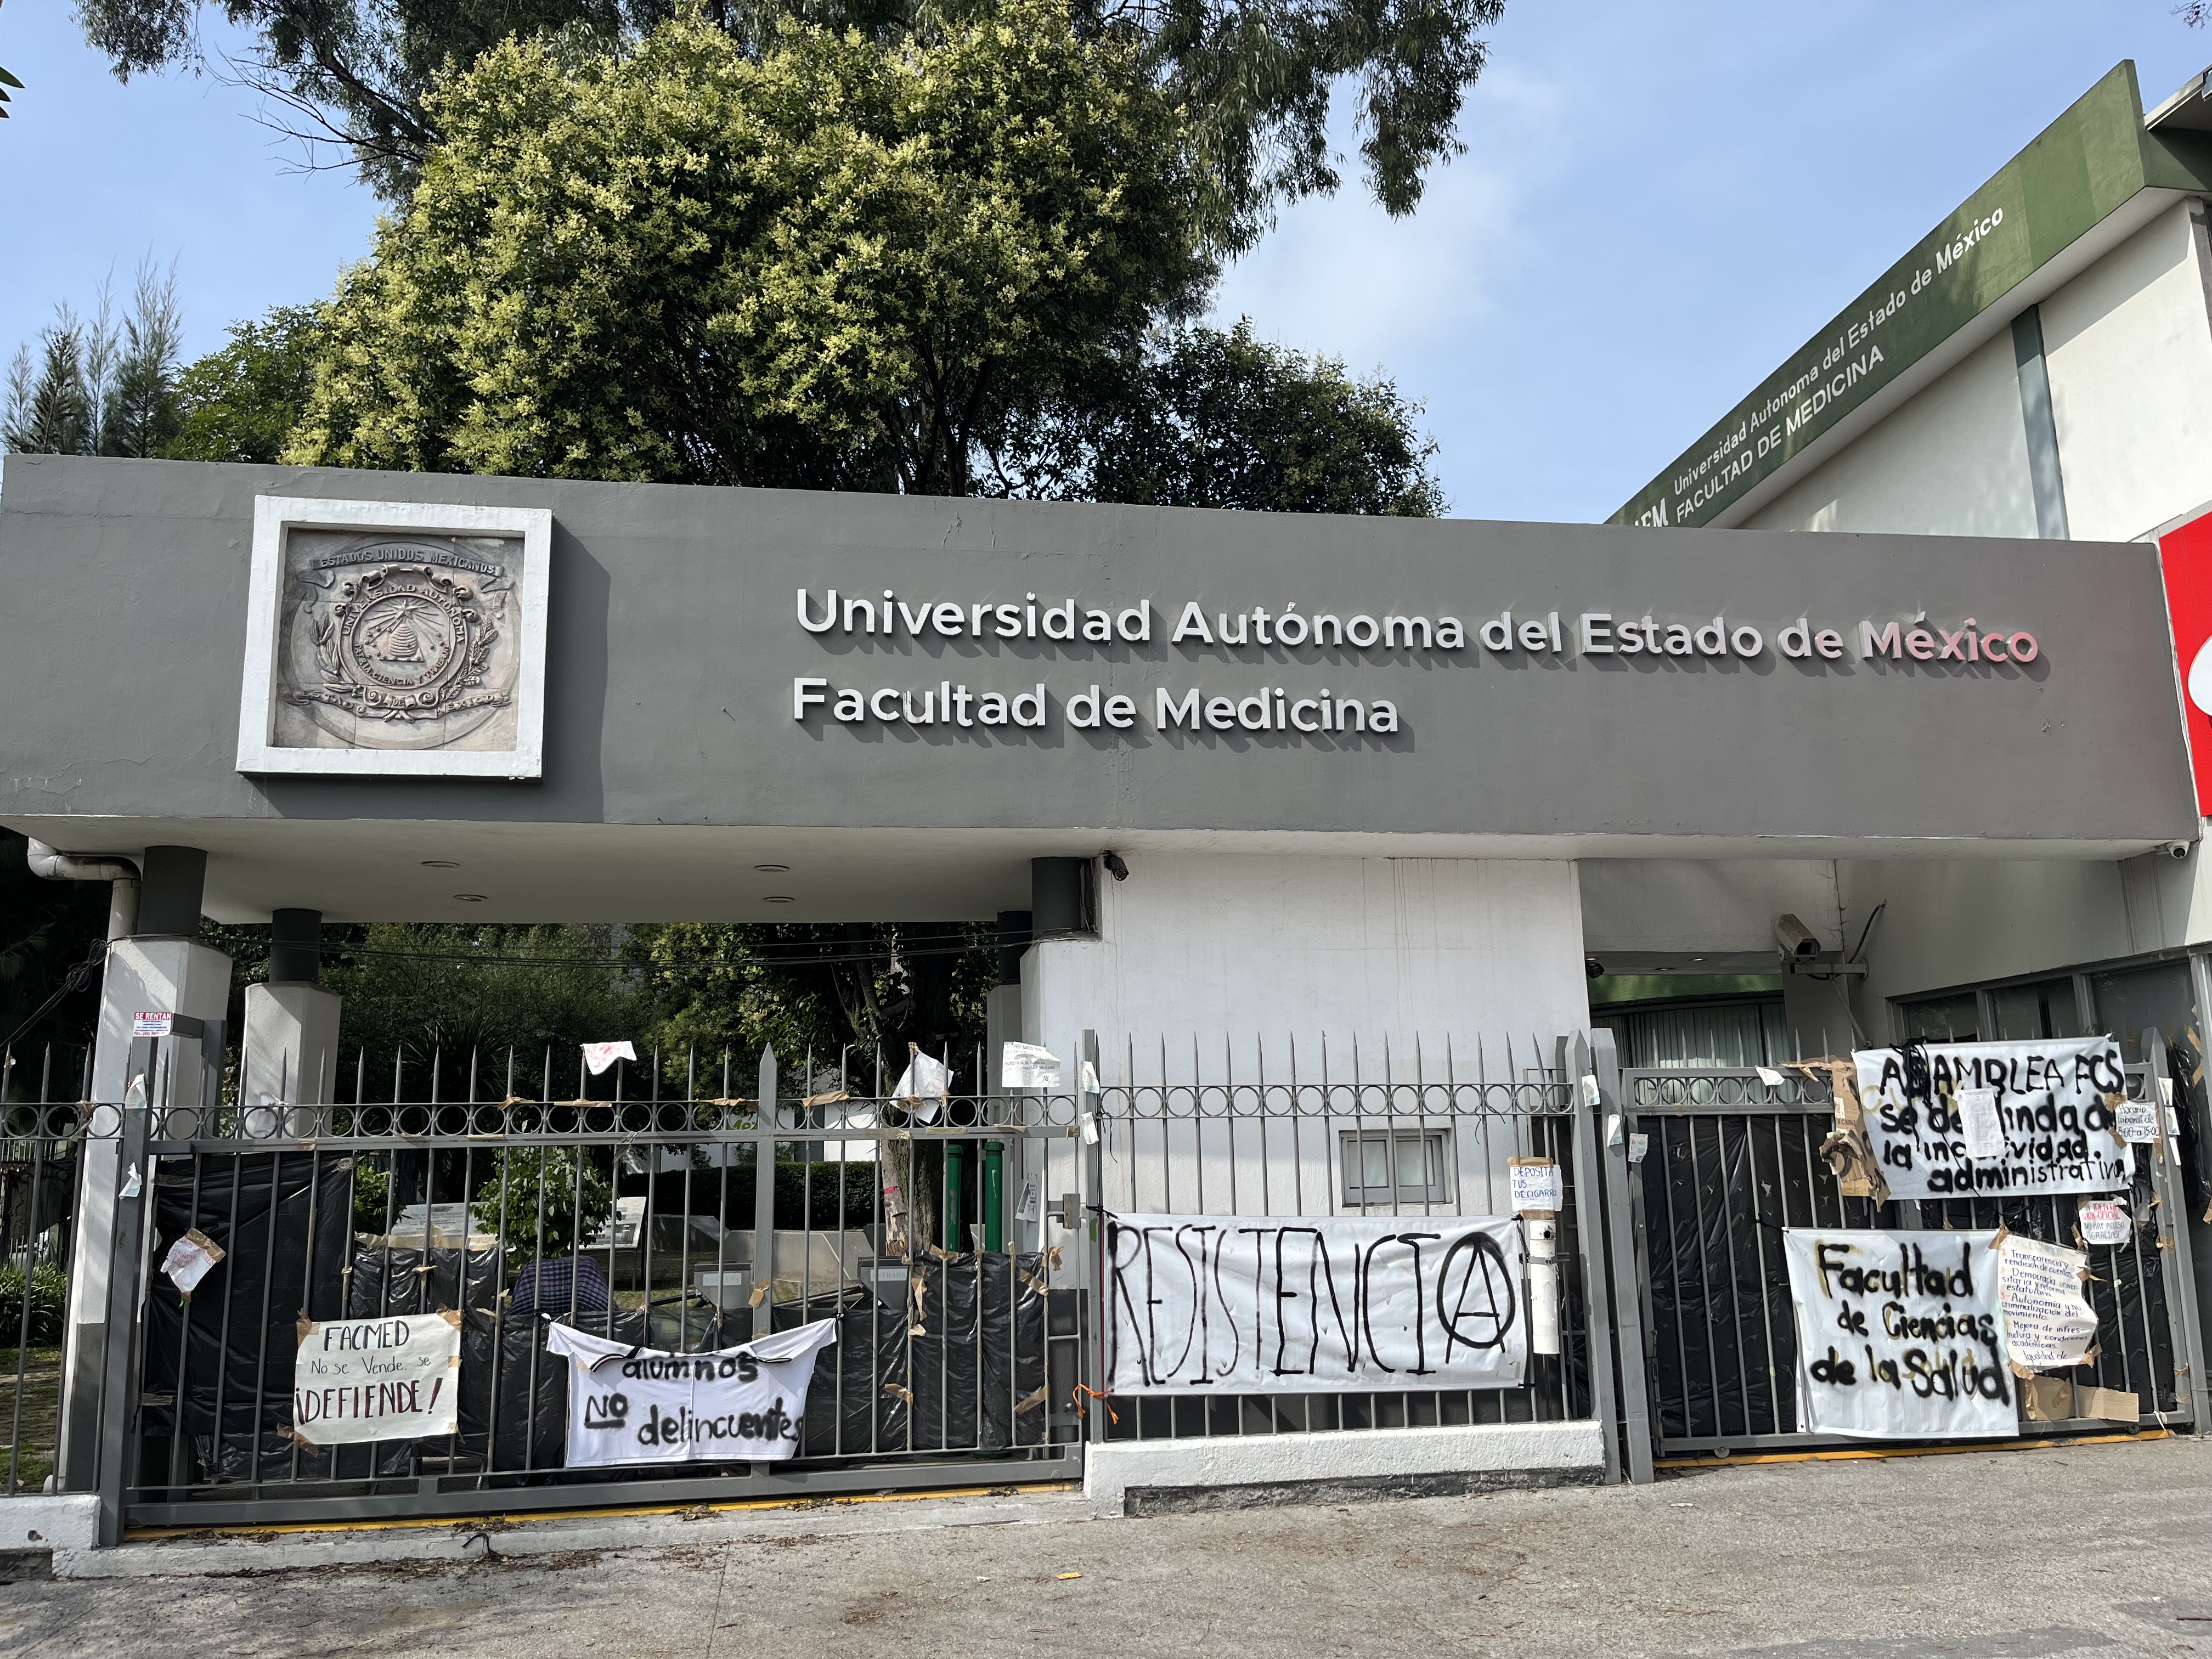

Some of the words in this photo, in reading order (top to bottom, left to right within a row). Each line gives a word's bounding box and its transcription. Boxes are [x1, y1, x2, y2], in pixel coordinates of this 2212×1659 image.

[1674, 418, 1747, 496] Universidad
[1822, 337, 1846, 371] del
[1848, 290, 1906, 350] Estado
[1910, 268, 1932, 296] de
[1935, 207, 2004, 275] México
[1676, 449, 1753, 523] FACULTAD
[1757, 426, 1782, 458] DE
[1786, 344, 1884, 437] MEDICINA
[1634, 497, 1669, 528] EM
[320, 550, 373, 567] ESTADOS
[377, 549, 425, 562] UNIDOS
[430, 553, 496, 575] MEXICANOS
[341, 584, 417, 636] UNIVERSIDAD
[795, 588, 1151, 643] Universidad
[1171, 600, 1466, 654] Autónoma
[1479, 610, 1562, 654] del
[1581, 612, 1764, 659] Estado
[1777, 617, 1844, 659] de
[1860, 610, 2041, 665] México
[372, 672, 413, 687] CIENCIA
[415, 675, 424, 686] Y
[300, 689, 368, 715] ESTADO
[392, 696, 405, 708] DE
[793, 677, 1046, 729] Facultad
[1065, 684, 1137, 730] de
[1155, 687, 1400, 734] Medicina
[2075, 1049, 2124, 1095] FCS
[1880, 1103, 1918, 1135] se
[1928, 1091, 2081, 1137] delinda
[2118, 1104, 2146, 1114] Horario
[2118, 1114, 2142, 1124] laboral
[2144, 1114, 2154, 1123] de
[1883, 1139, 1912, 1171] la
[1512, 1180, 1527, 1188] TUS
[1514, 1167, 1554, 1177] DEPOSITA
[1527, 1189, 1557, 1198] CIGARRO
[1817, 1242, 1973, 1298] Facultad
[2011, 1249, 2062, 1268] Transparencia
[2040, 1263, 2048, 1271] de
[2002, 1275, 2032, 1285] sitaria
[2040, 1283, 2066, 1295] reforma
[2012, 1268, 2056, 1285] Democracia
[1107, 1221, 1516, 1388] RESISTENCIA
[2011, 1293, 2061, 1309] Autonomía
[324, 1320, 410, 1351] FACMED
[1837, 1302, 1869, 1336] de
[1883, 1301, 1997, 1346] Ciencias
[2013, 1320, 2039, 1332] Mejora
[2034, 1334, 2040, 1343] y
[311, 1360, 328, 1374] No
[334, 1362, 349, 1375] se
[417, 1357, 431, 1367] se
[622, 1352, 758, 1383] alumnos
[2023, 1350, 2055, 1365] Igualdad
[2057, 1351, 2067, 1359] de
[1810, 1345, 1856, 1386] de
[1866, 1344, 1901, 1390] la
[1903, 1345, 2010, 1407] Salud
[585, 1392, 629, 1421] NO
